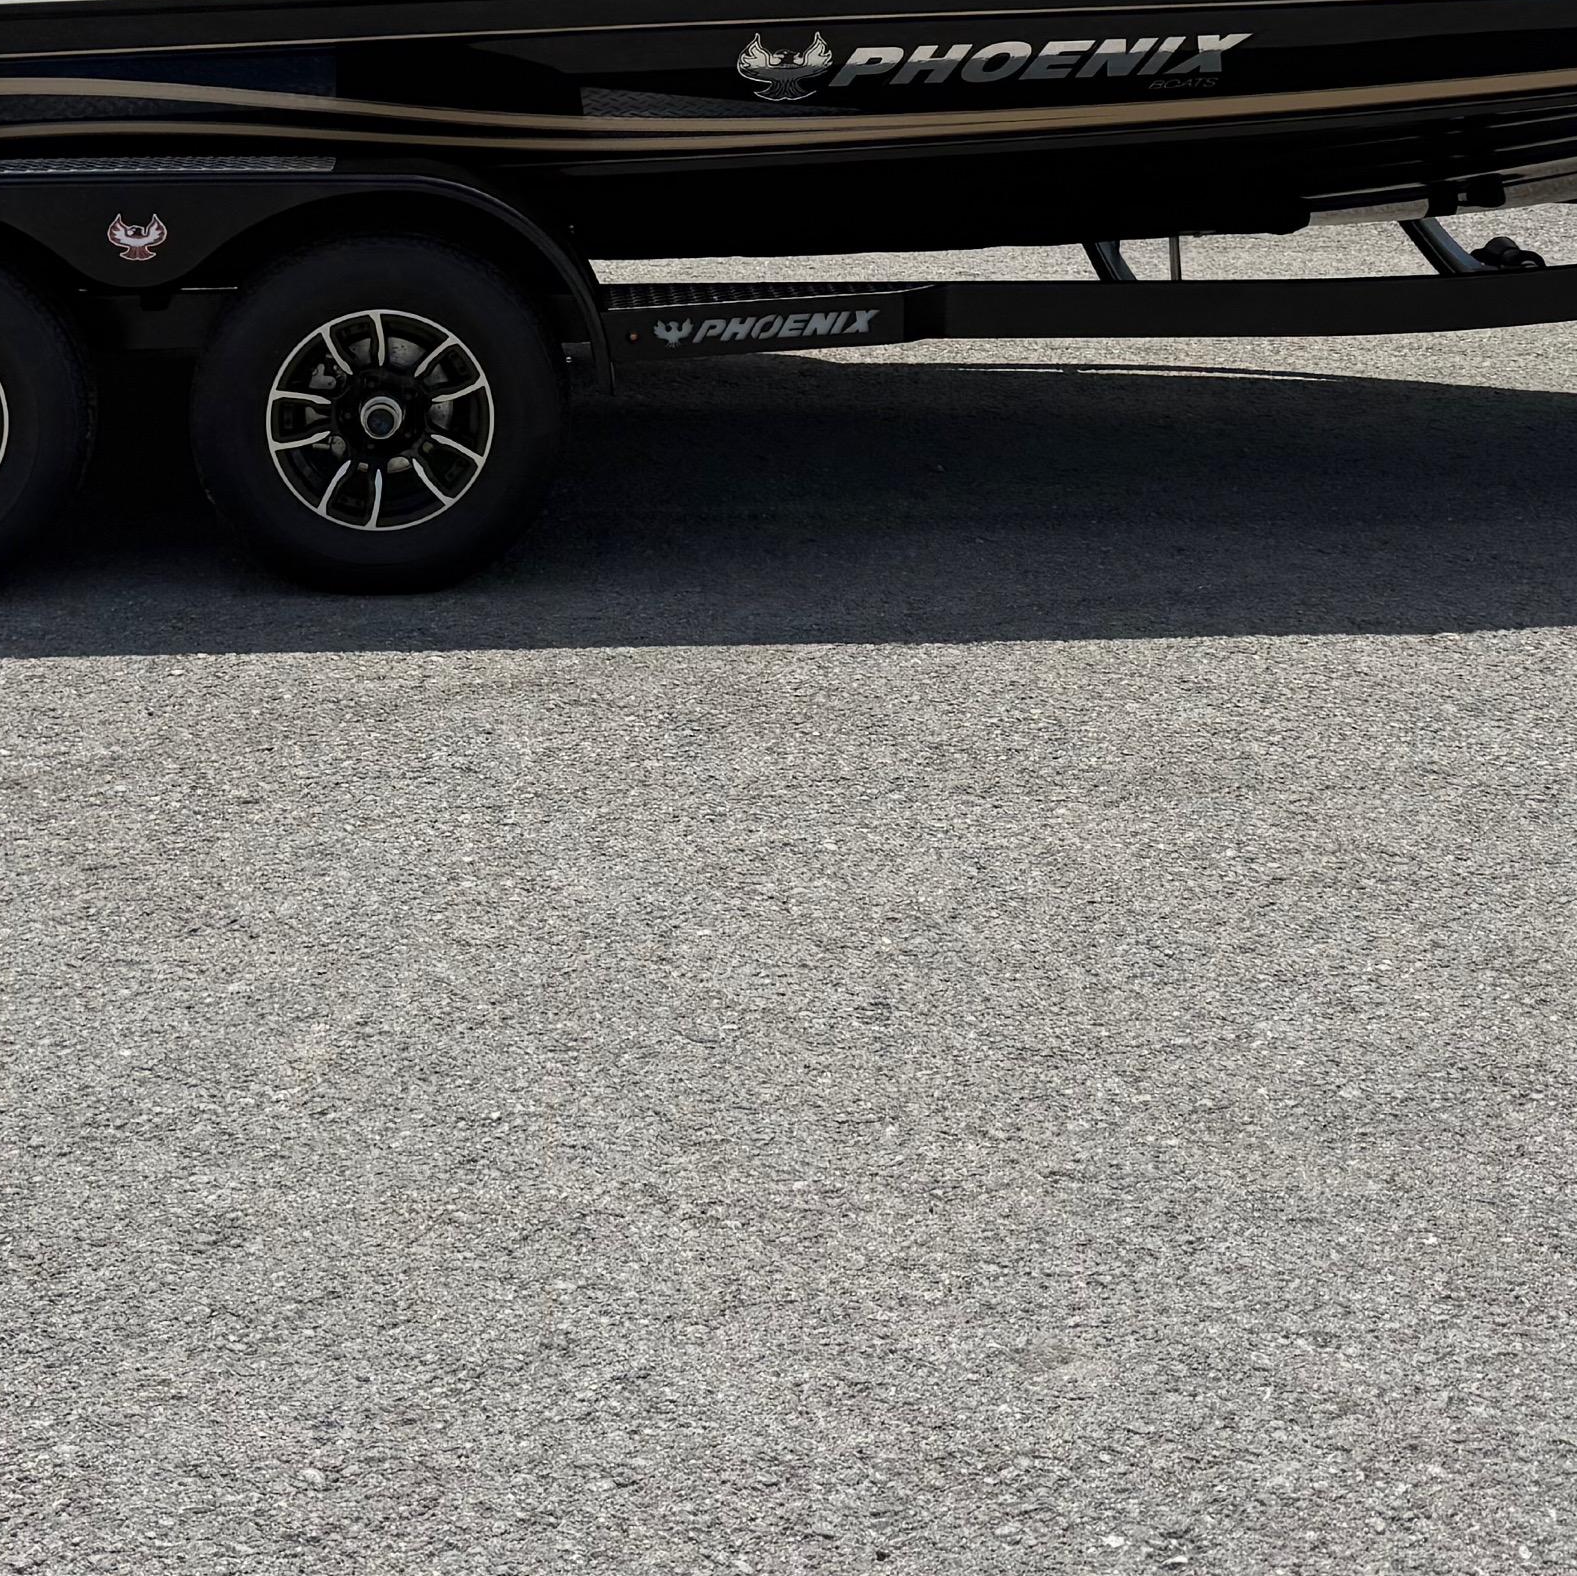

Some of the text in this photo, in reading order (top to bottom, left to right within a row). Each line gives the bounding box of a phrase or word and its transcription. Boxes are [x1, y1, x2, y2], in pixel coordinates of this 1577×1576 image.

[828, 33, 1253, 88] PHOENIX
[1148, 76, 1219, 90] BOATS
[692, 309, 880, 343] PHOENIX
